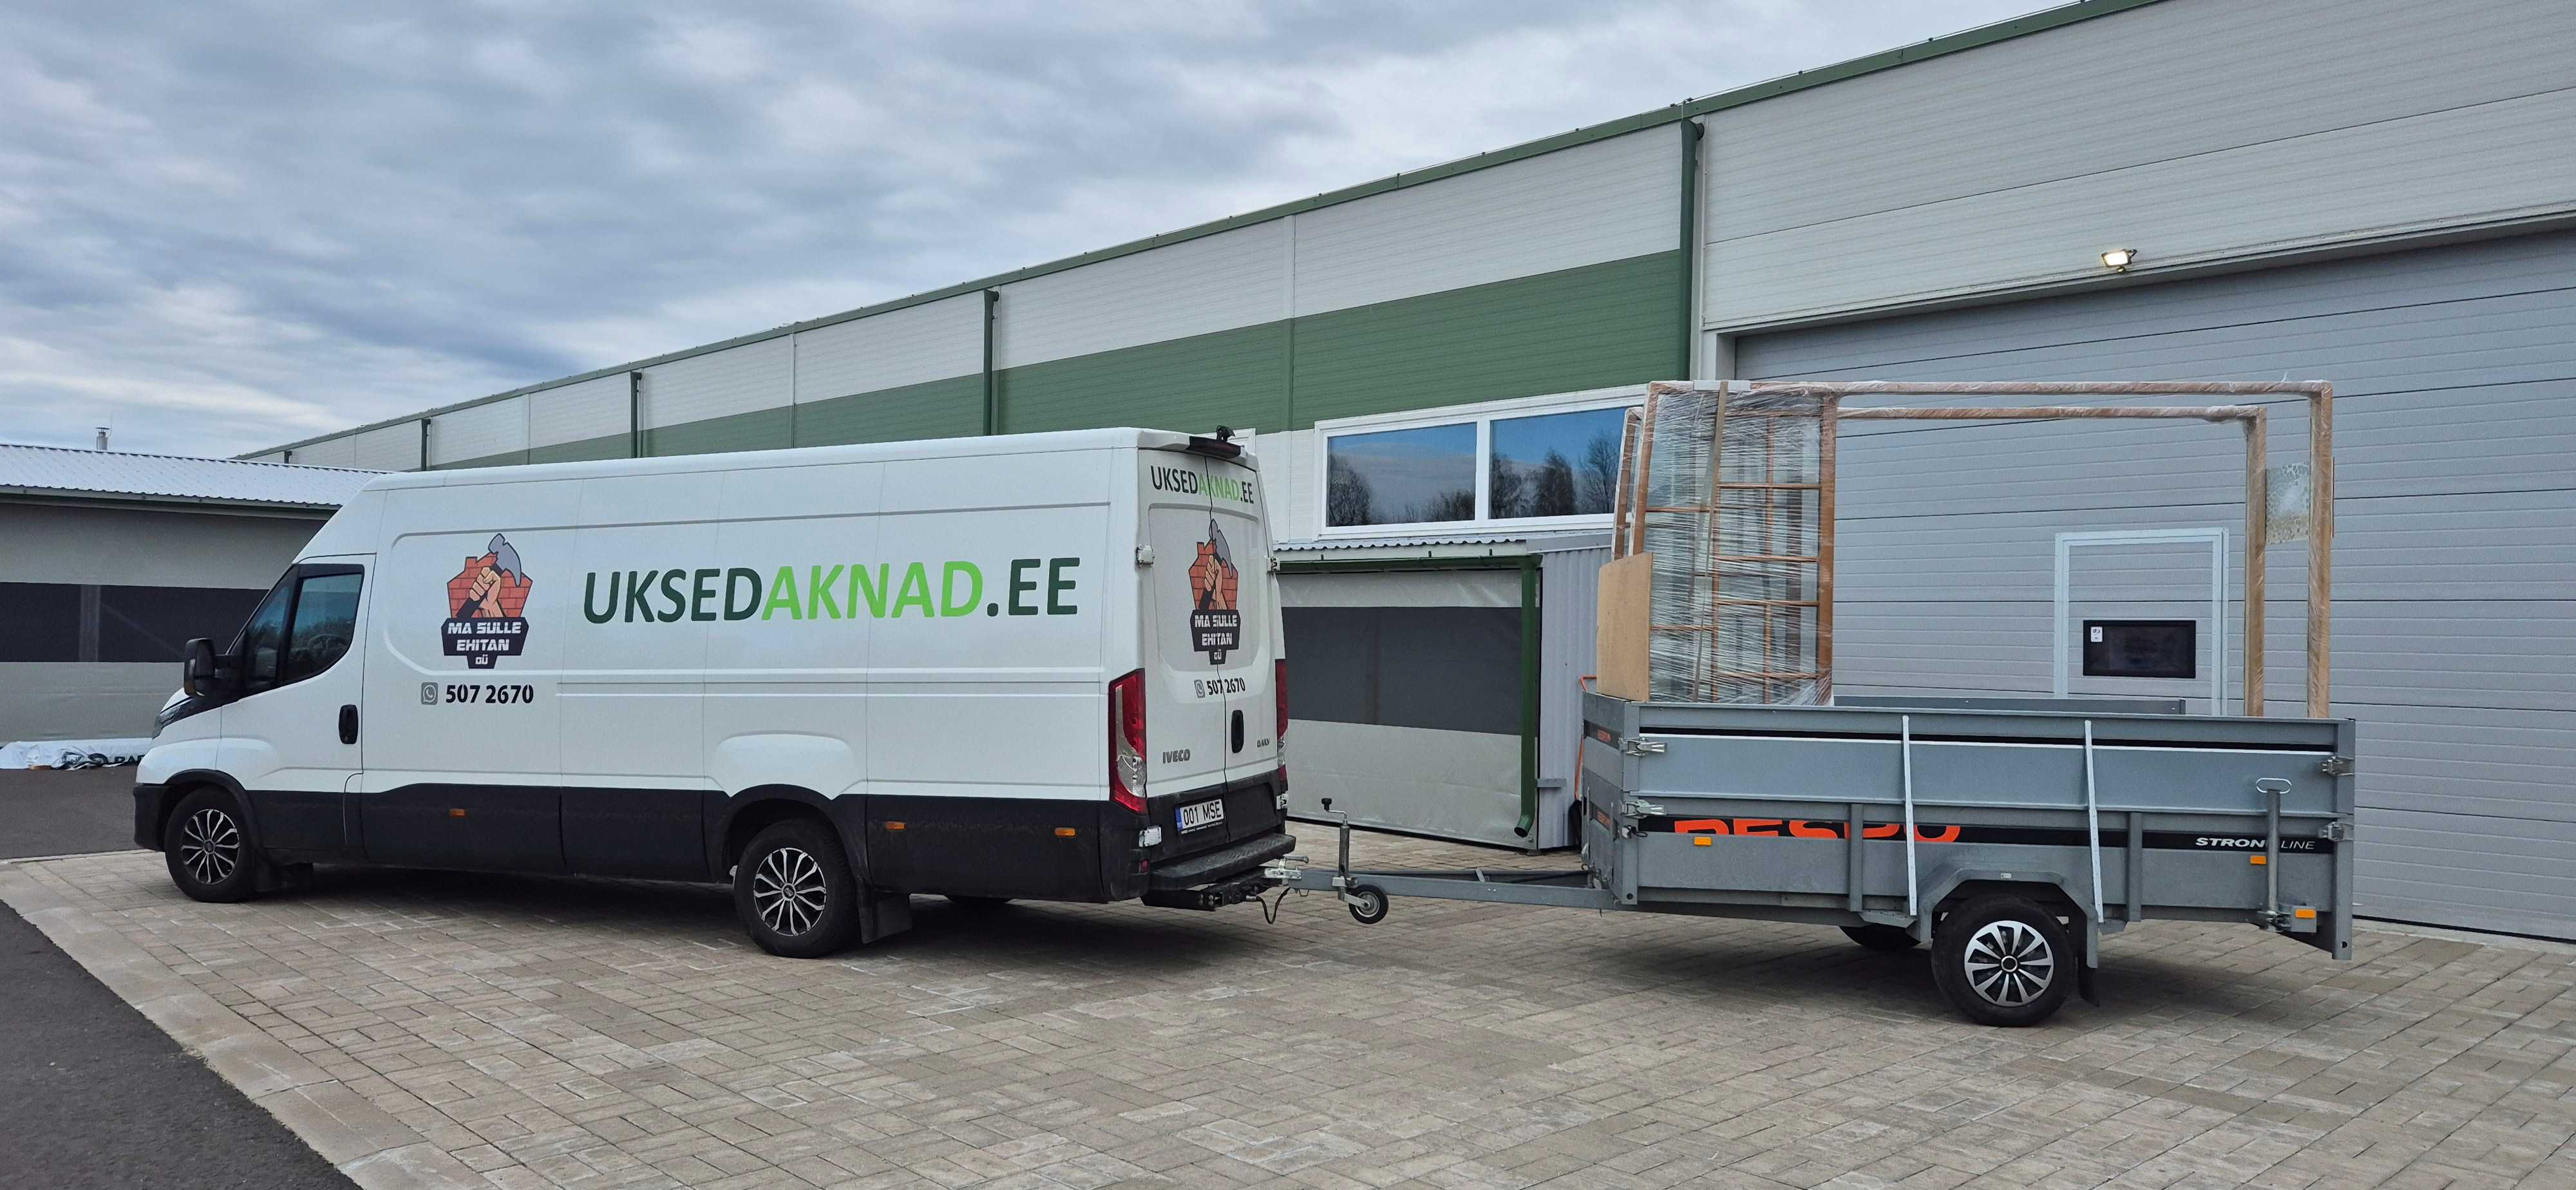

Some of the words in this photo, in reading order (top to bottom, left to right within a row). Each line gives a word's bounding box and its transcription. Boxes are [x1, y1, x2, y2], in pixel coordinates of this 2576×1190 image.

[1151, 466, 1255, 504] UKSEDAKNAD.EE
[583, 557, 1081, 623] UKSEDAKNAD.EE
[448, 622, 472, 634] MA
[476, 621, 522, 634] SULLE
[1195, 615, 1211, 628] MA
[1212, 614, 1238, 627] SULLE
[456, 639, 509, 651] EHITAN
[1202, 632, 1233, 646] EHITAN
[446, 684, 480, 703] 507
[485, 685, 534, 704] 2670
[1206, 679, 1223, 695] 507
[1224, 677, 1245, 694] 2670
[1162, 748, 1191, 764] IVECO
[1183, 806, 1199, 826] 001
[1202, 800, 1222, 821] MSE
